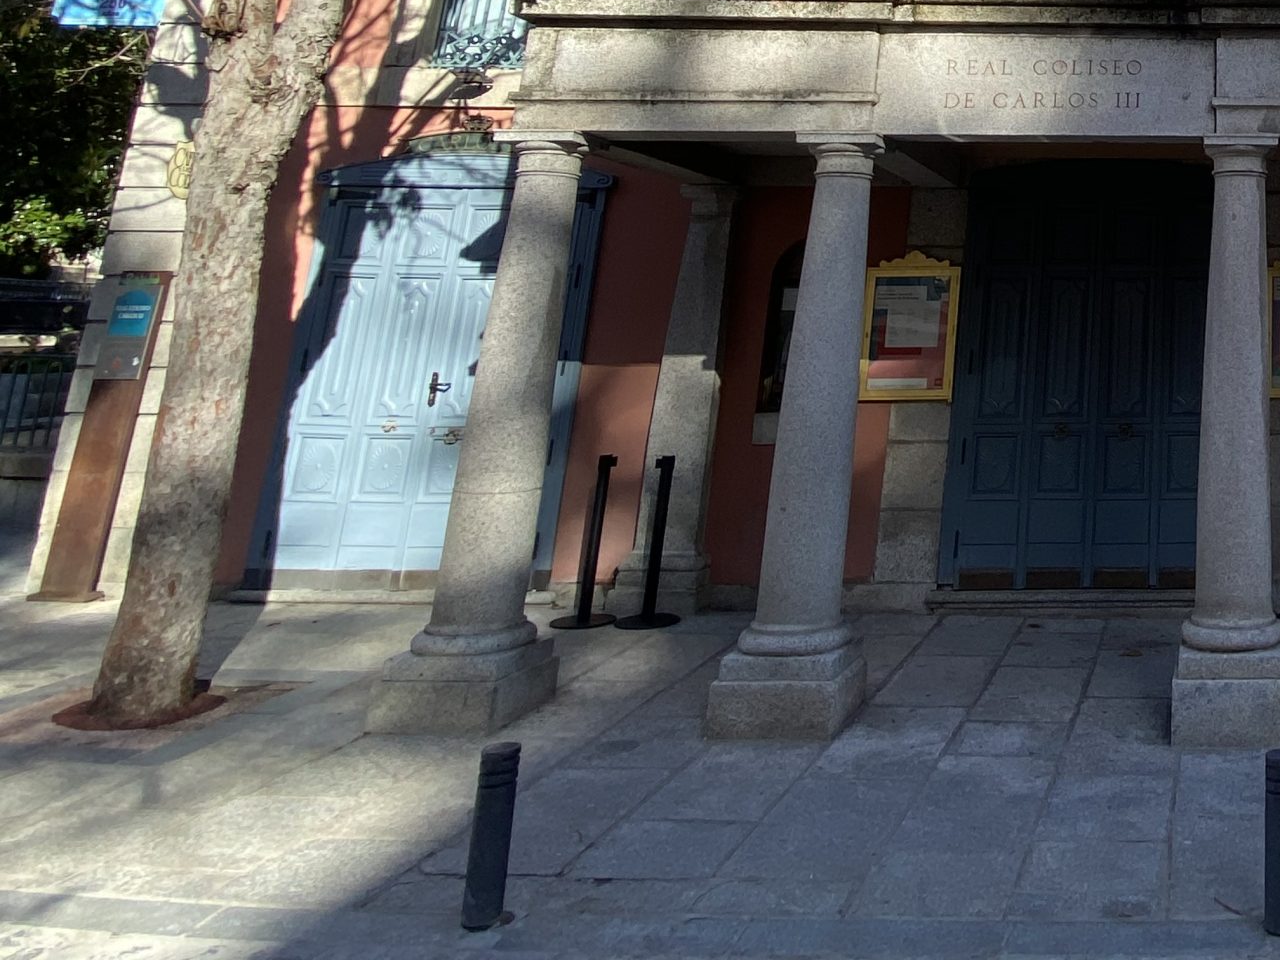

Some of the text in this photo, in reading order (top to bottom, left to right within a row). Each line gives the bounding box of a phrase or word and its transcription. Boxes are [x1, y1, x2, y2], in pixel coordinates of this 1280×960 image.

[947, 59, 1142, 76] REAL COLISEO
[944, 92, 1142, 109] DE CARLOS III
